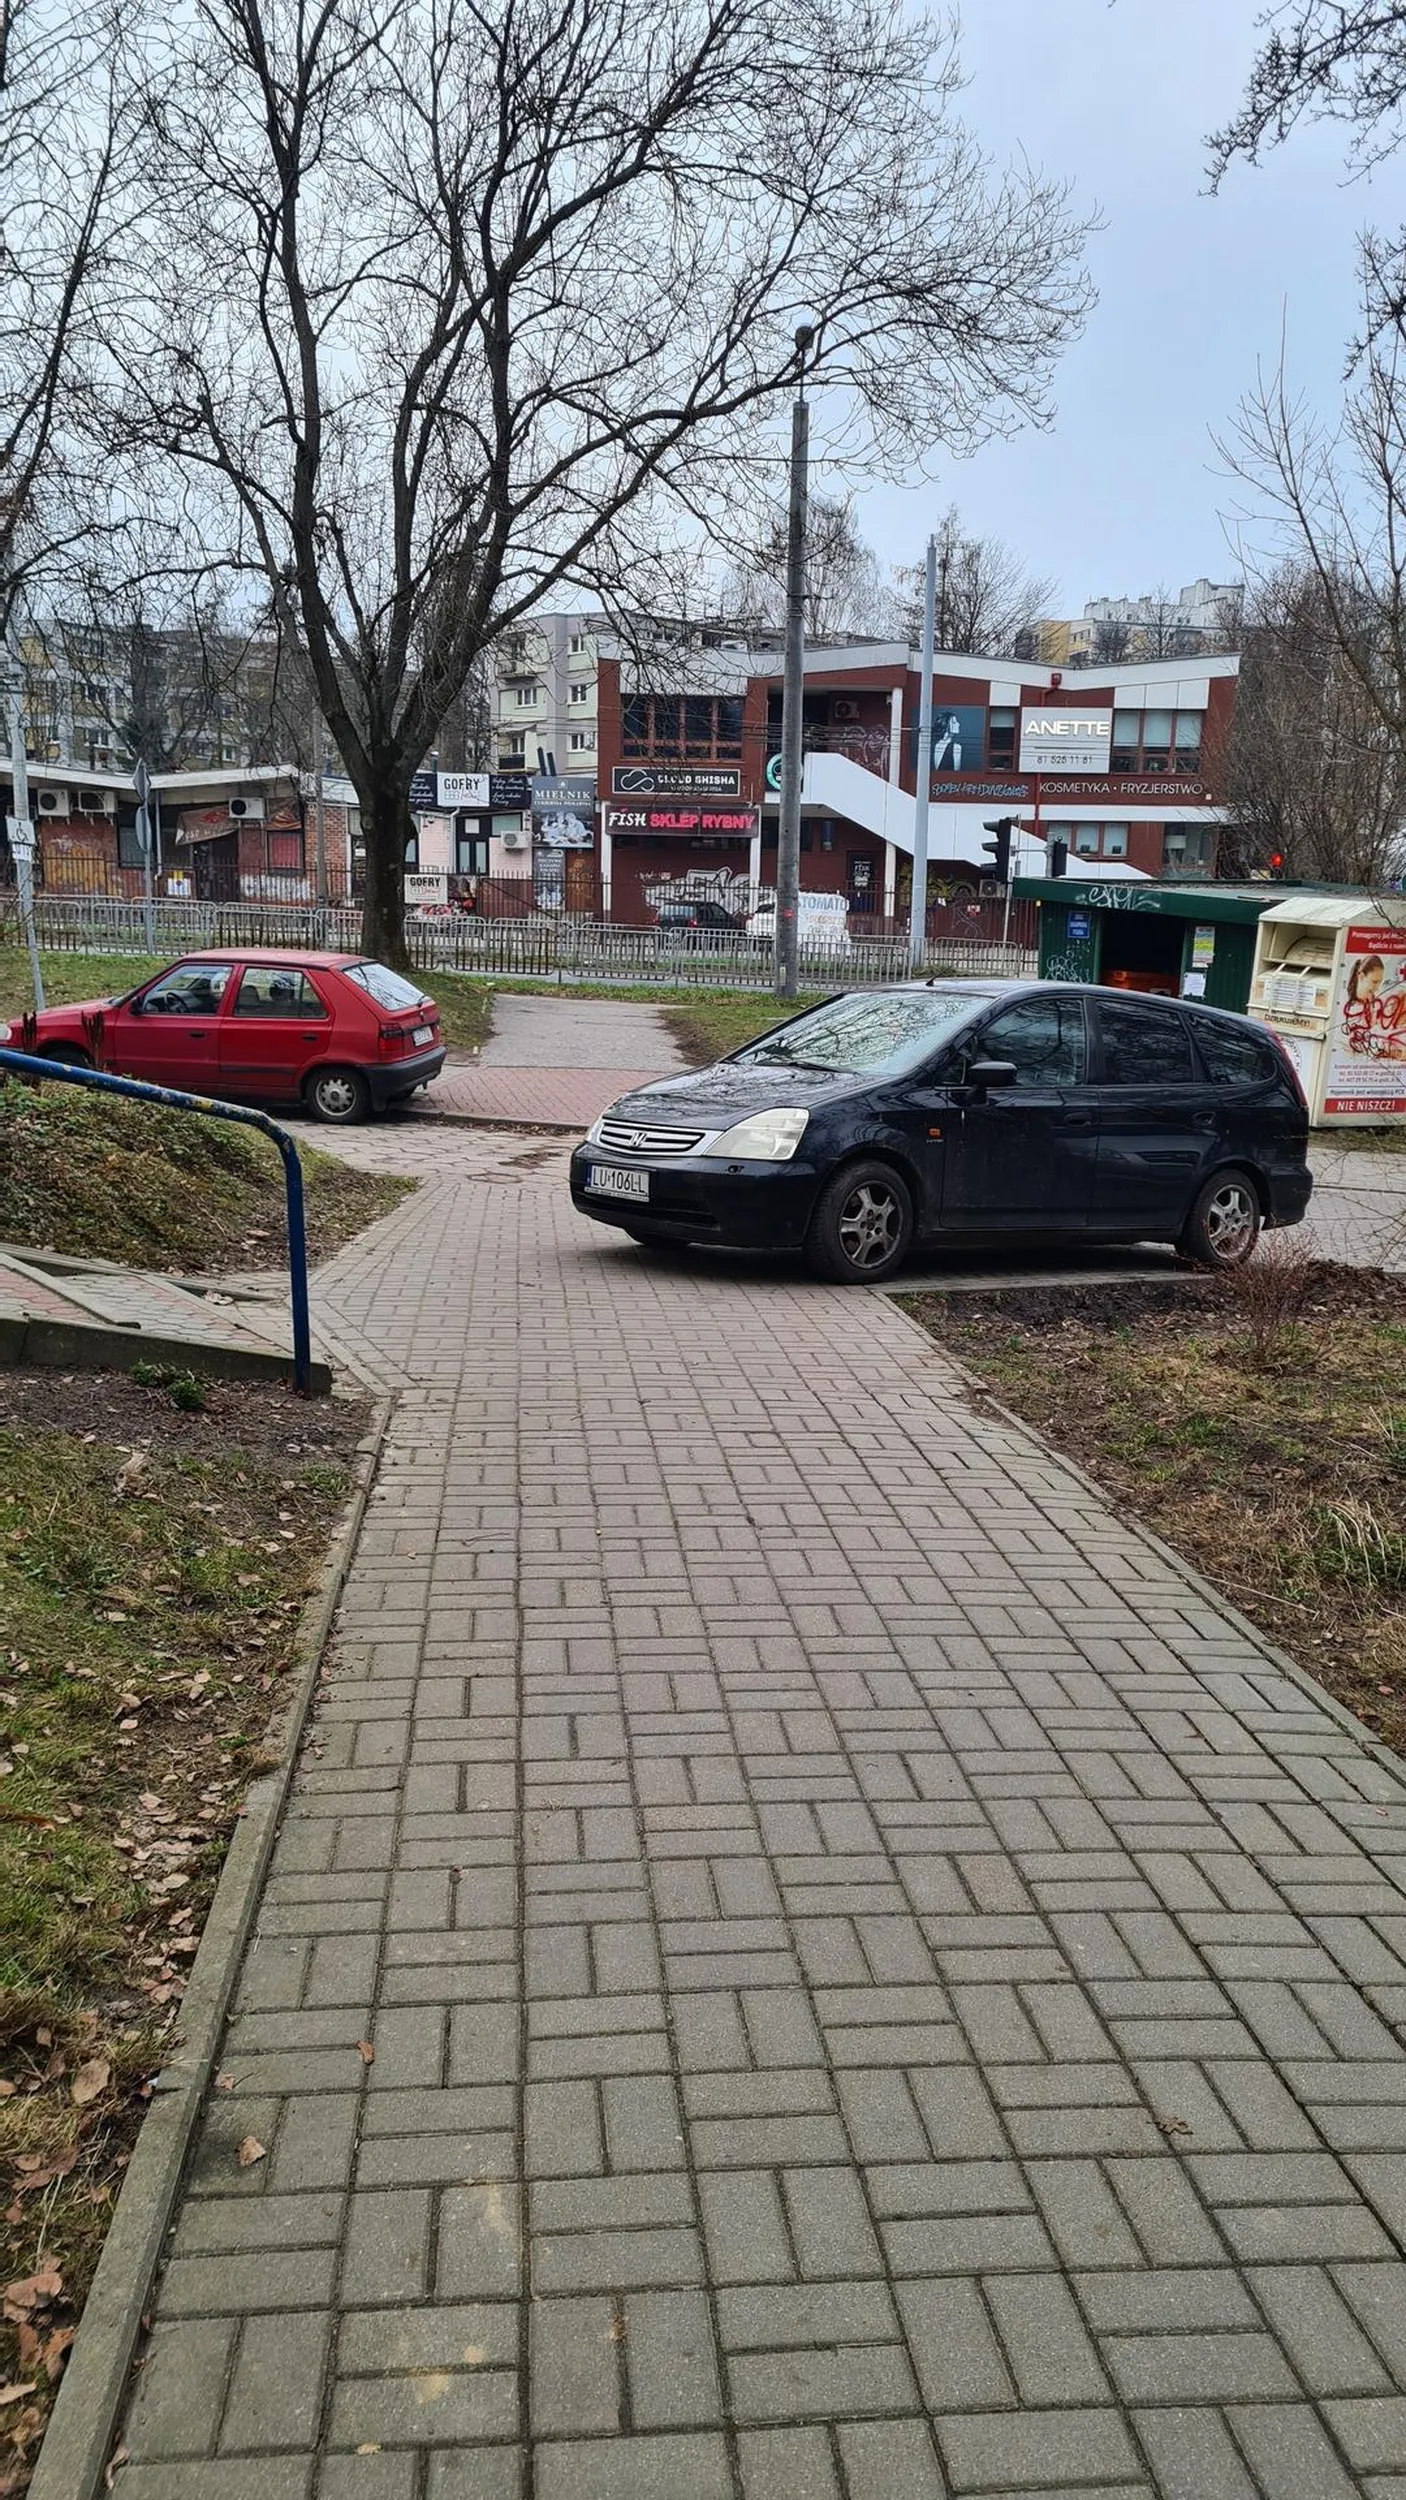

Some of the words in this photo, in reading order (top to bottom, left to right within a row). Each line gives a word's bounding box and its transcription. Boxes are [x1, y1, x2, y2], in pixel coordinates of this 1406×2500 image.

[1025, 719, 1110, 737] ANETTE
[443, 778, 480, 790] GOFRY
[657, 774, 692, 784] CLOUD
[694, 774, 736, 785] SHISHA
[534, 789, 591, 799] MIELNIK
[1039, 782, 1110, 793] KOSMETYKA
[1121, 783, 1203, 795] FRYZJERSTWO
[650, 813, 699, 828] SKLEP
[702, 814, 755, 828] RYBNY
[410, 876, 441, 887] GOFRY
[798, 896, 847, 911] TOMATO
[1336, 1101, 1354, 1111] NIE
[1356, 1100, 1395, 1111] NISZCZ!
[592, 1167, 608, 1187] LU
[611, 1171, 646, 1193] 106LL
